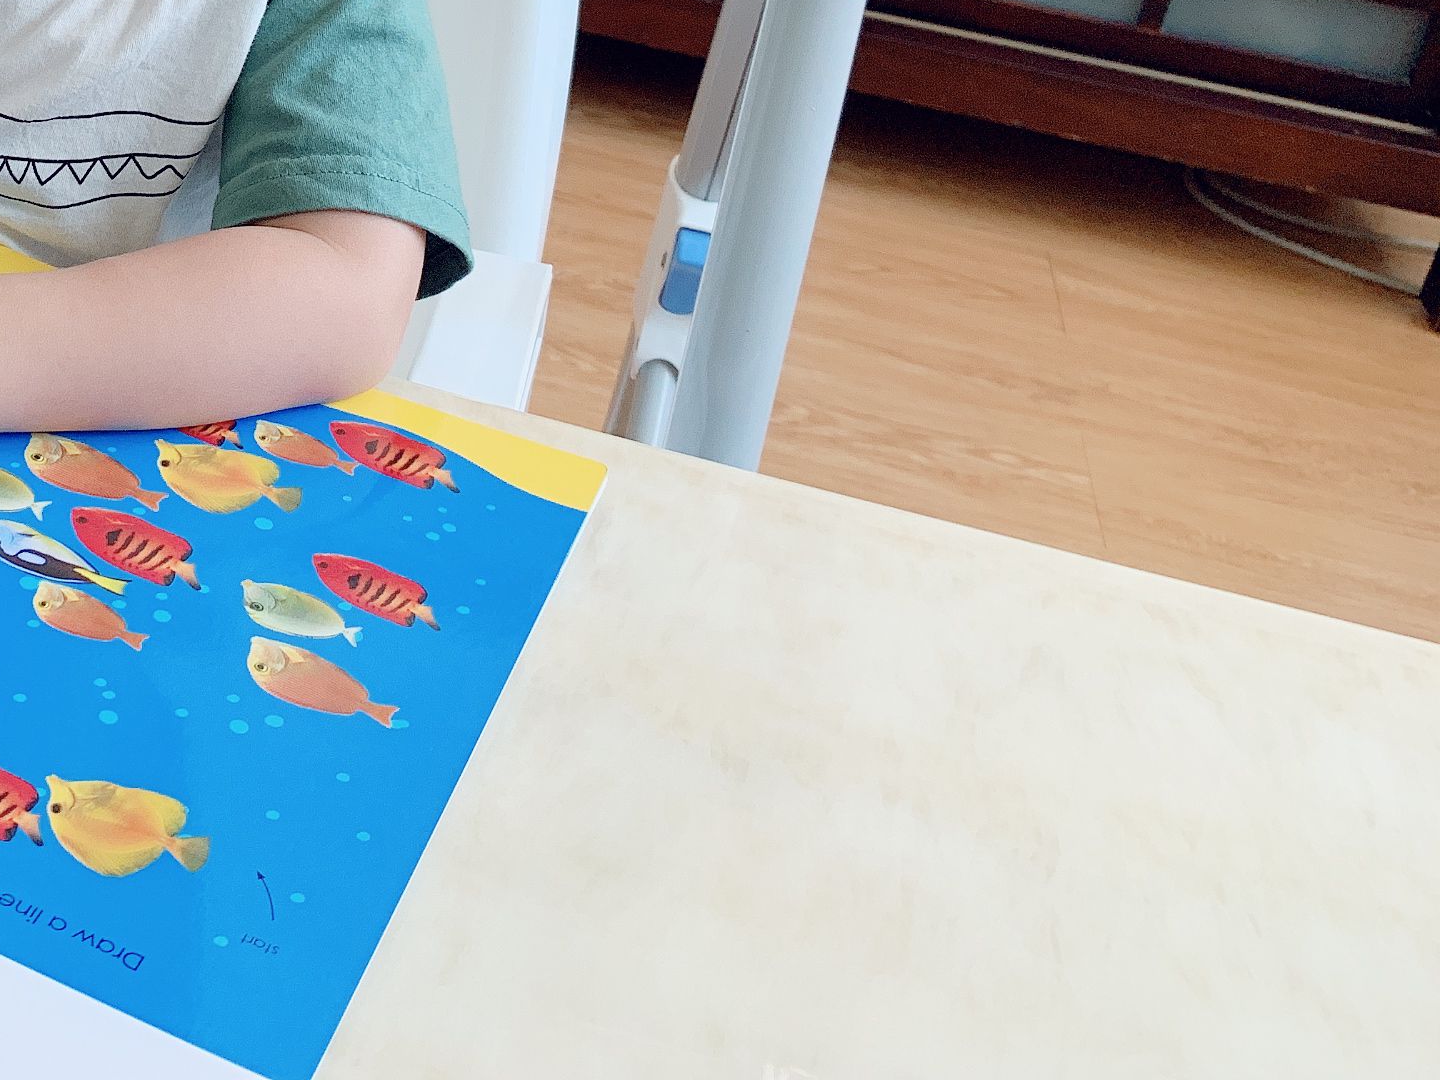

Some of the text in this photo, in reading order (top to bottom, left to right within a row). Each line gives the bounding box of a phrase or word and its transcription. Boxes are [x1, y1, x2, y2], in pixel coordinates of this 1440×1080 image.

[47, 916, 68, 933] a
[71, 928, 146, 972] Draw
[241, 933, 280, 955] start
